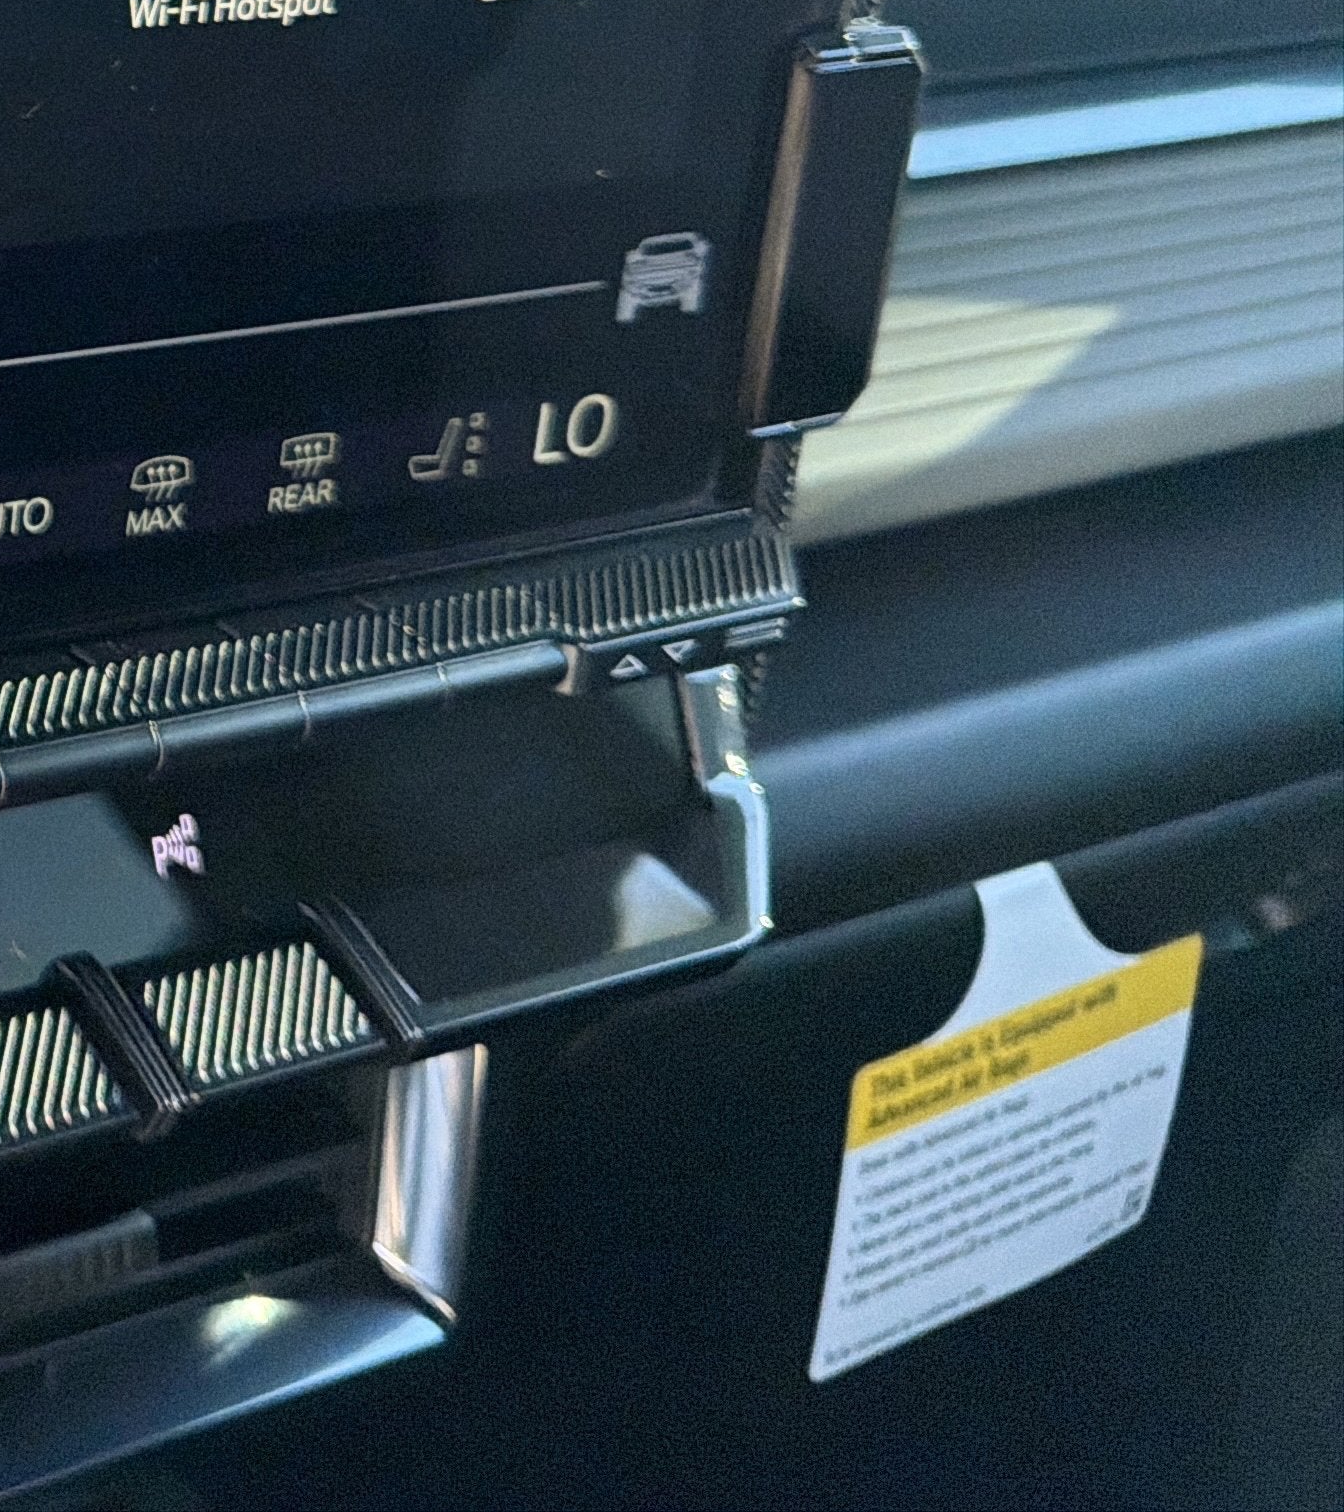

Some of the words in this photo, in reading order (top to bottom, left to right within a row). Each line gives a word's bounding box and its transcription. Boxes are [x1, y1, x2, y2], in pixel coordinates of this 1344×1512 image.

[533, 393, 615, 464] LO
[267, 478, 334, 511] REAR
[125, 504, 183, 535] MAX
